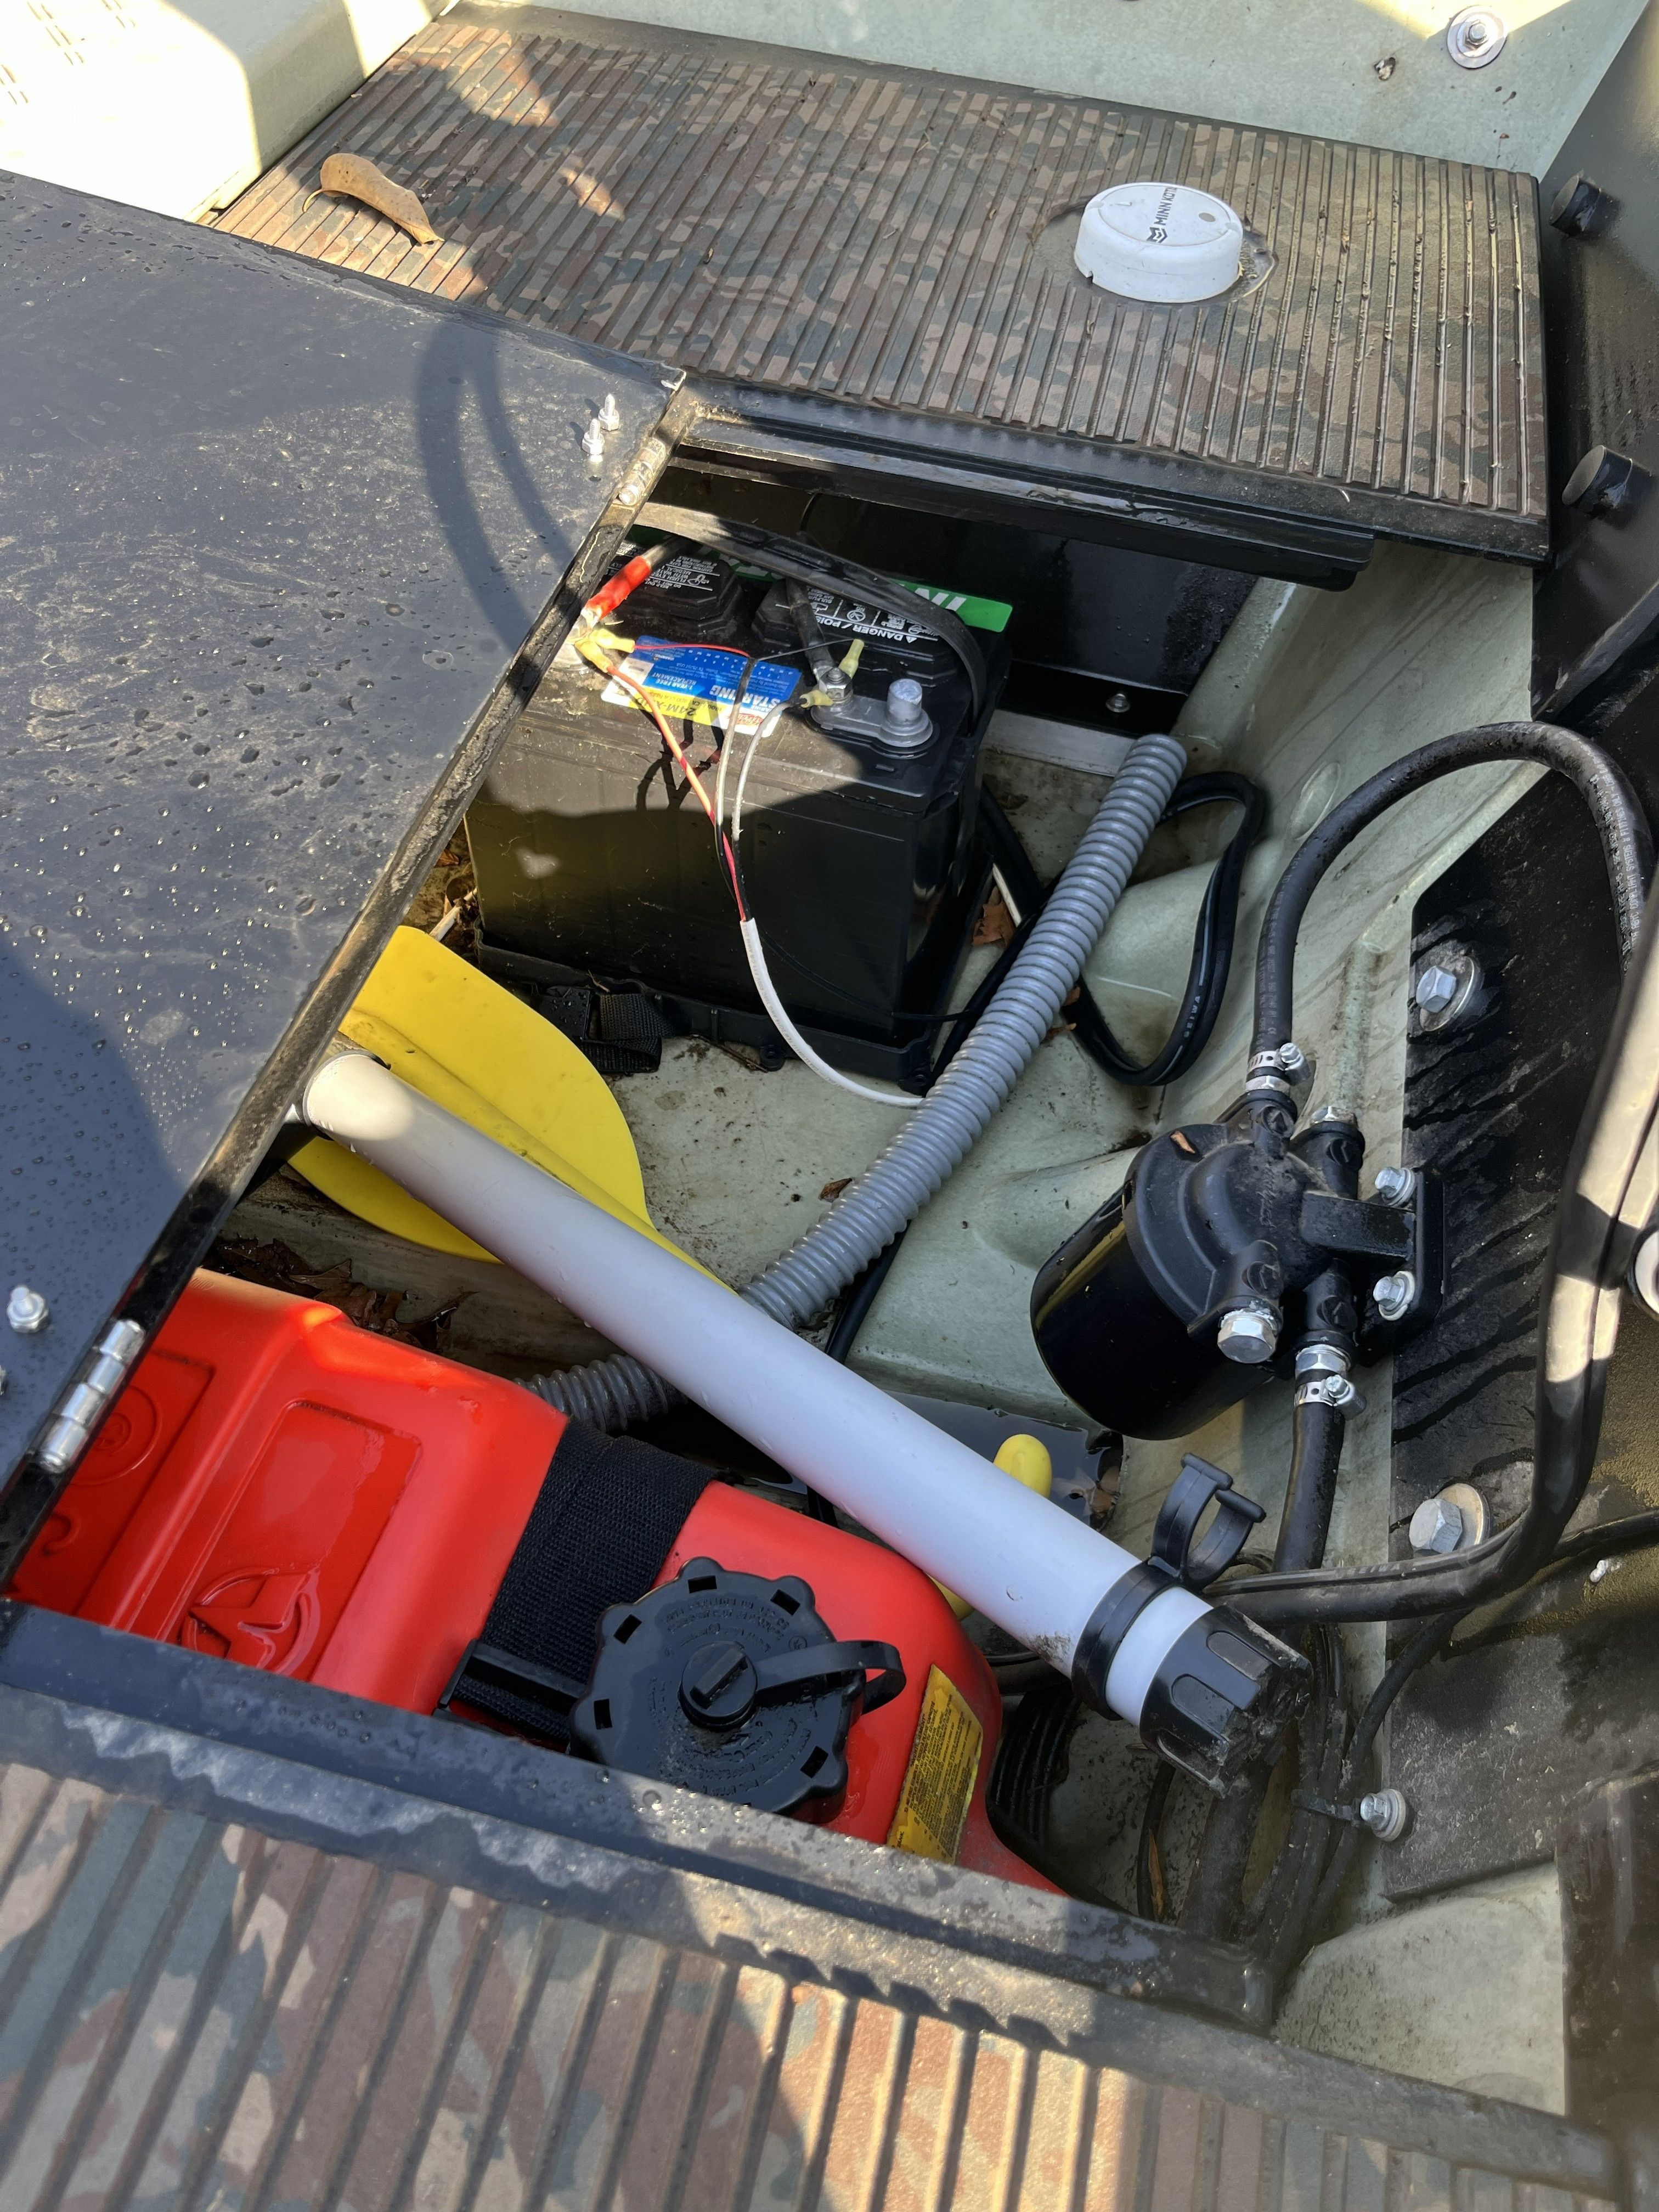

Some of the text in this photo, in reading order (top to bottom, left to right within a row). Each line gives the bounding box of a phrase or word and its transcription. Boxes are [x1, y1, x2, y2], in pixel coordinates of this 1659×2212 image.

[1154, 202, 1172, 225] MINN
[666, 566, 691, 575] MEDICAL
[814, 616, 841, 628] POIS
[852, 624, 903, 641] DANGER
[651, 672, 697, 685] REPLACEMENT
[1623, 844, 1635, 871] SYSTEMS
